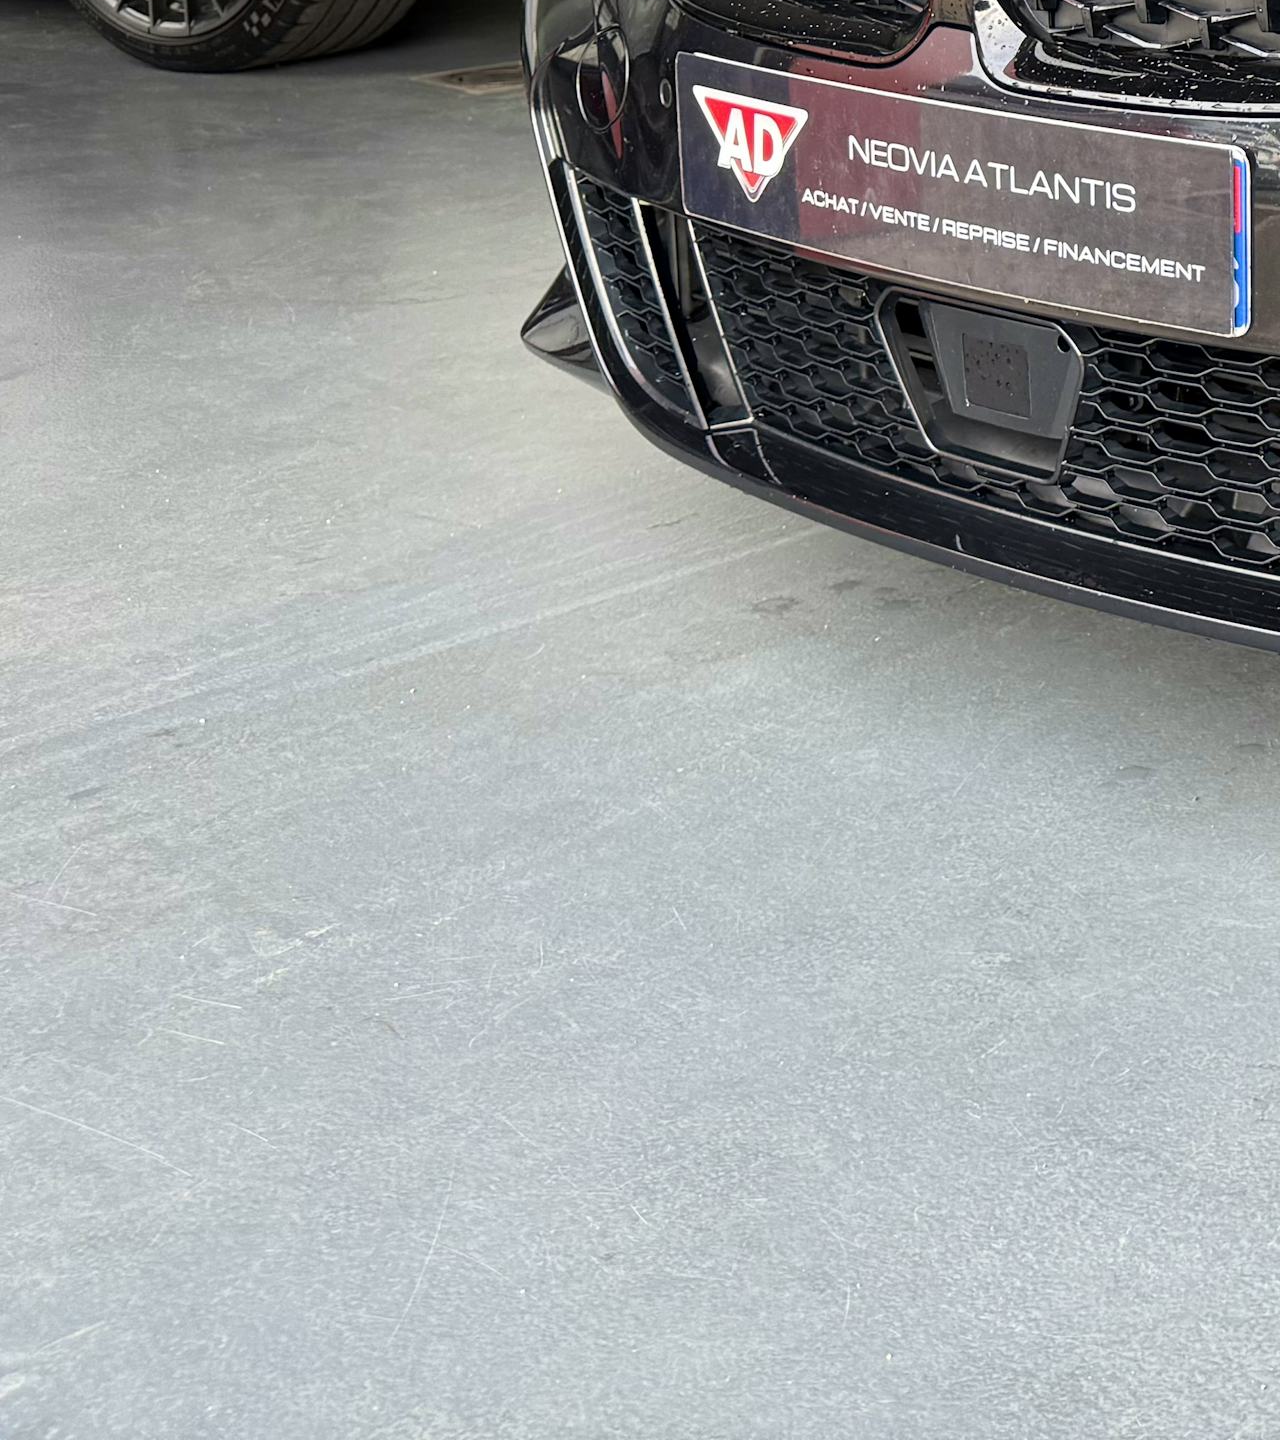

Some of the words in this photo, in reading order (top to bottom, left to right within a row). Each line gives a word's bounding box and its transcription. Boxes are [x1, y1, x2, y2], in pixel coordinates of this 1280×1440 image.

[717, 107, 784, 174] AD
[848, 134, 960, 182] NEOVIA
[964, 159, 1137, 213] ATLANTIS
[802, 188, 859, 216] ACHAT
[868, 204, 931, 231] VENTE
[943, 219, 1030, 251] REPRISE
[1044, 239, 1206, 283] FINANCEMENT
